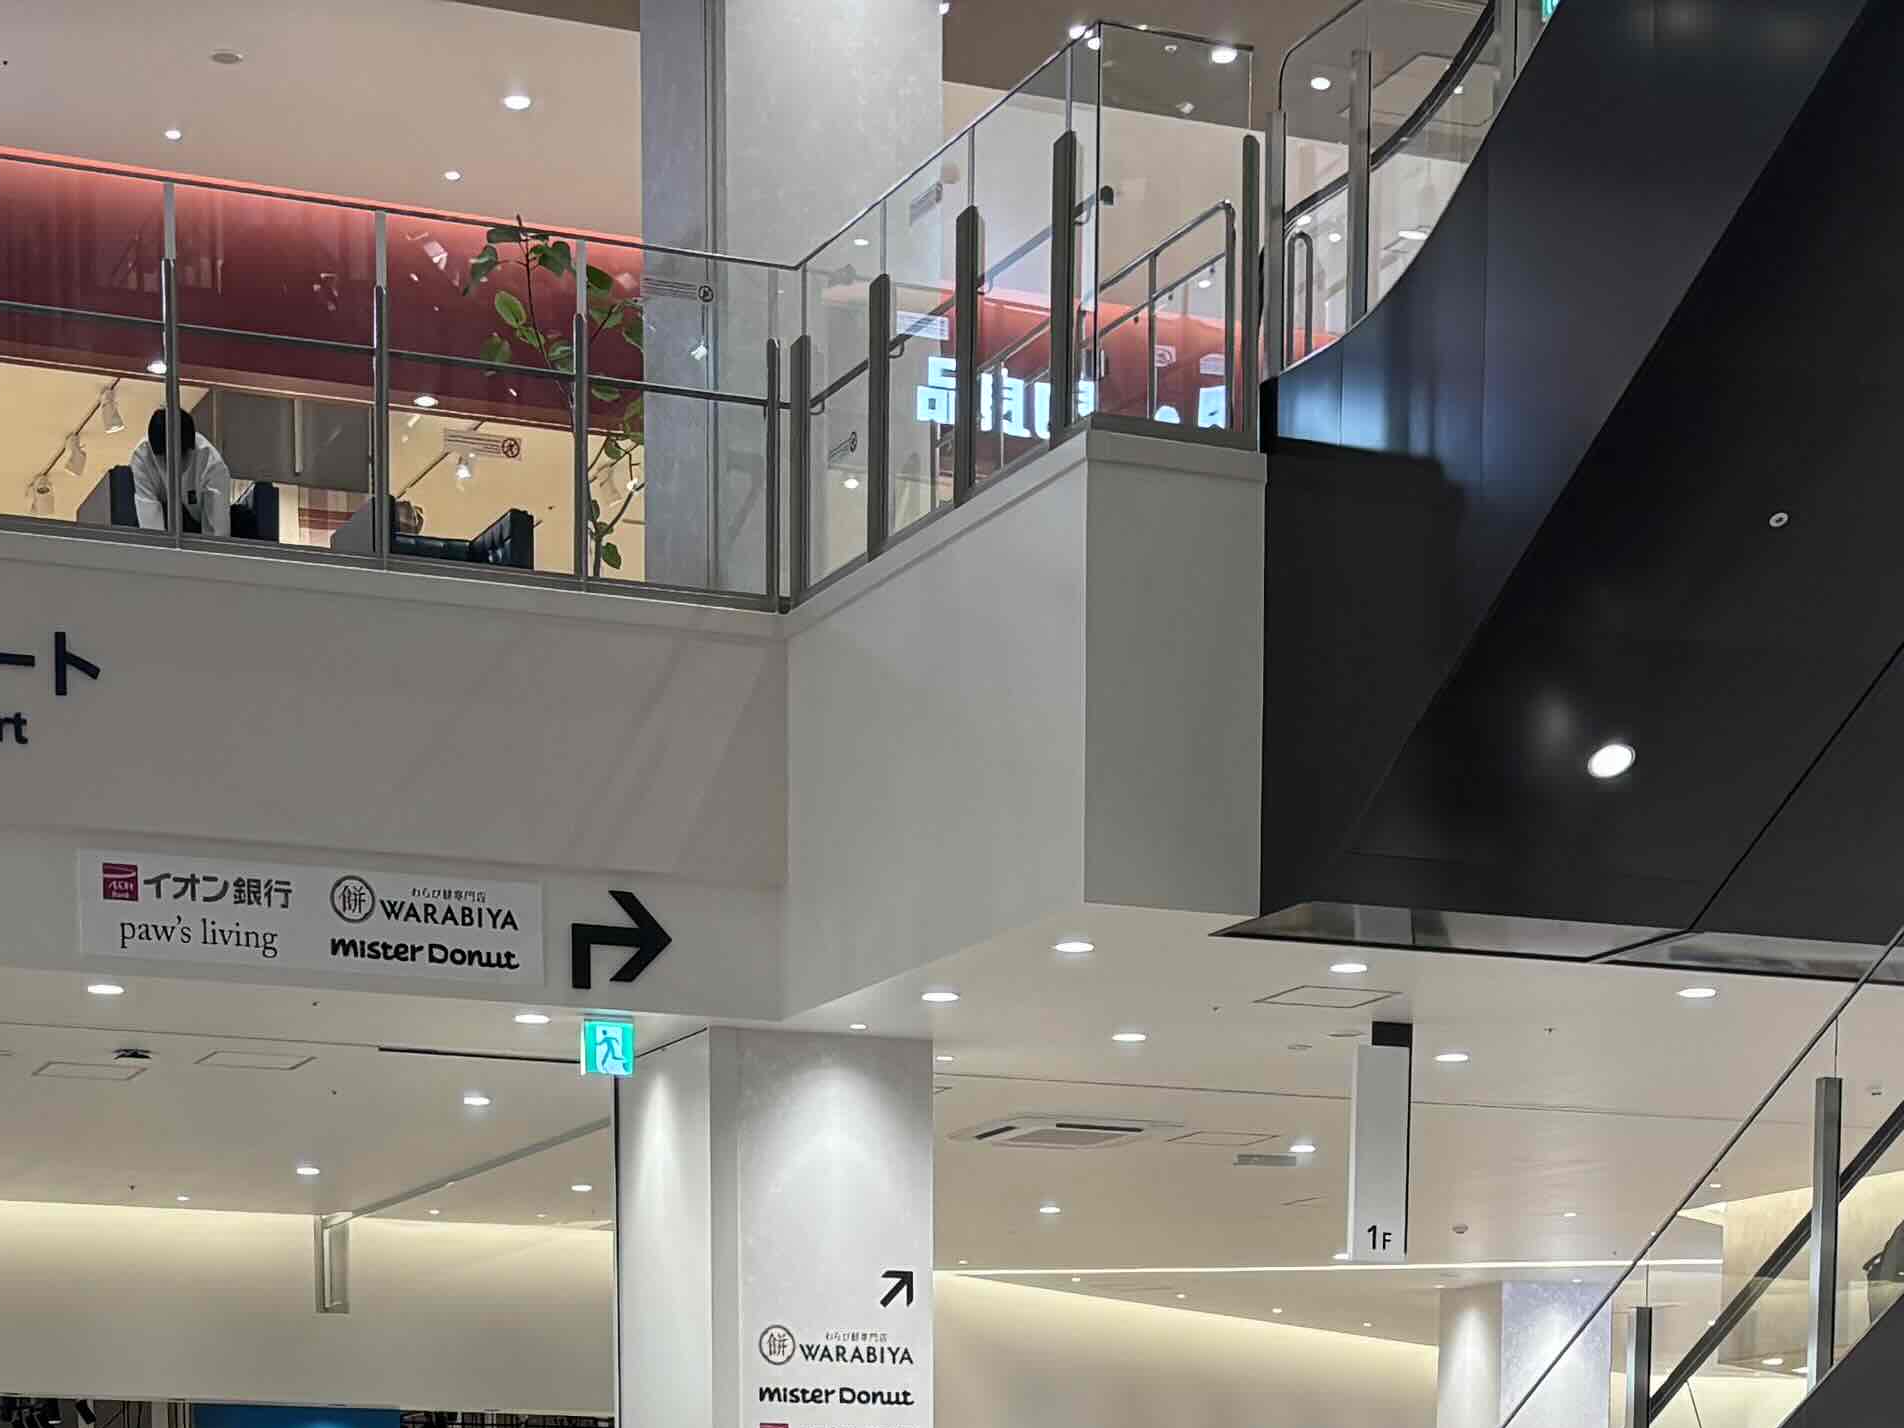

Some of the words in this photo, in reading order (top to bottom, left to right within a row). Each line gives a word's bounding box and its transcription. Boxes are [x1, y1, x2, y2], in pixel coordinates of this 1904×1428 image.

[144, 873, 292, 908] イオン銀行
[380, 900, 519, 931] WARABIYA
[120, 915, 191, 949] paw's
[201, 918, 278, 958] living
[428, 943, 520, 970] Donut
[1368, 1225, 1392, 1250] 1F
[799, 1344, 914, 1364] WARABIYA
[839, 1387, 915, 1405] Donut
